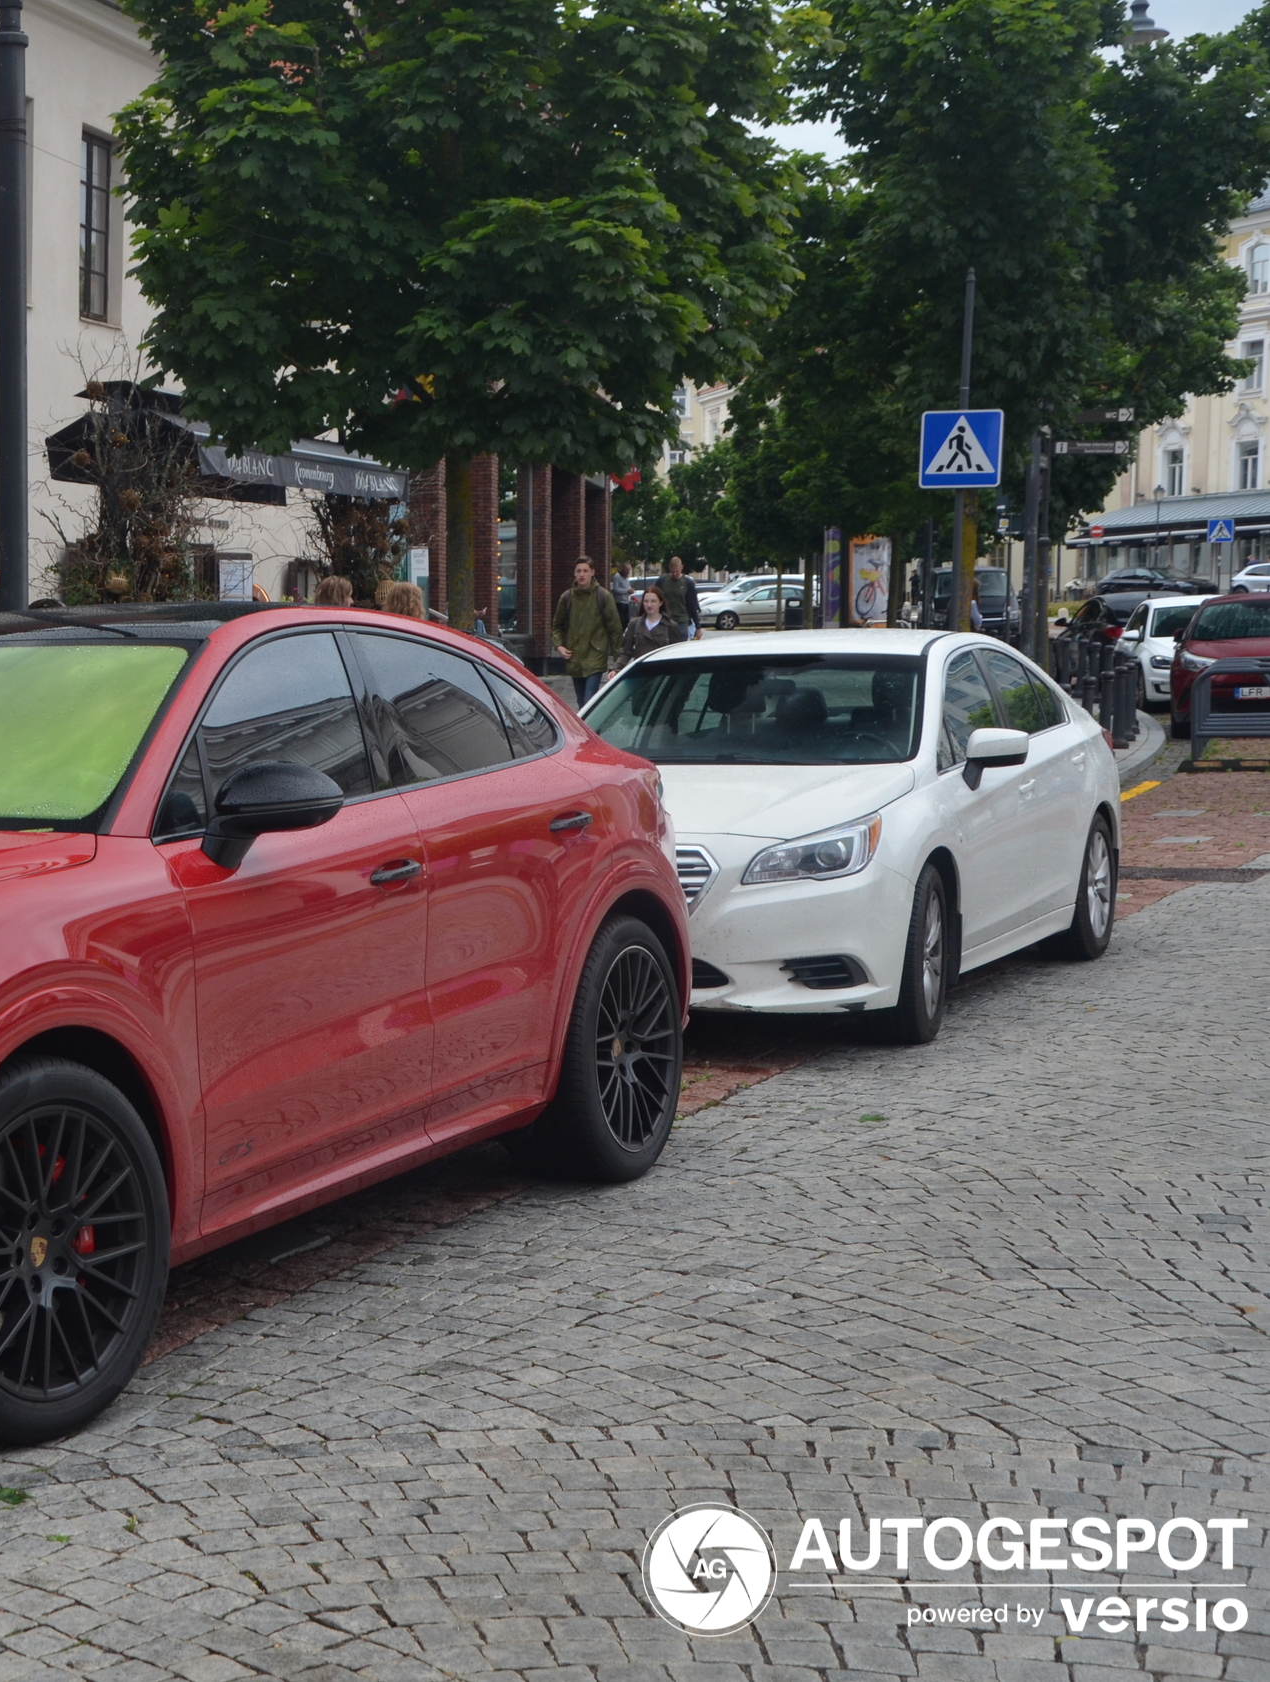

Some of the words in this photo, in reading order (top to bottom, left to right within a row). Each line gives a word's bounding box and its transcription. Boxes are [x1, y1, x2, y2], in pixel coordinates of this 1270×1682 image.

[242, 455, 274, 476] BLANC
[294, 461, 334, 490] Kronenbourg
[369, 474, 399, 492] BLANC
[1240, 687, 1263, 698] LFR
